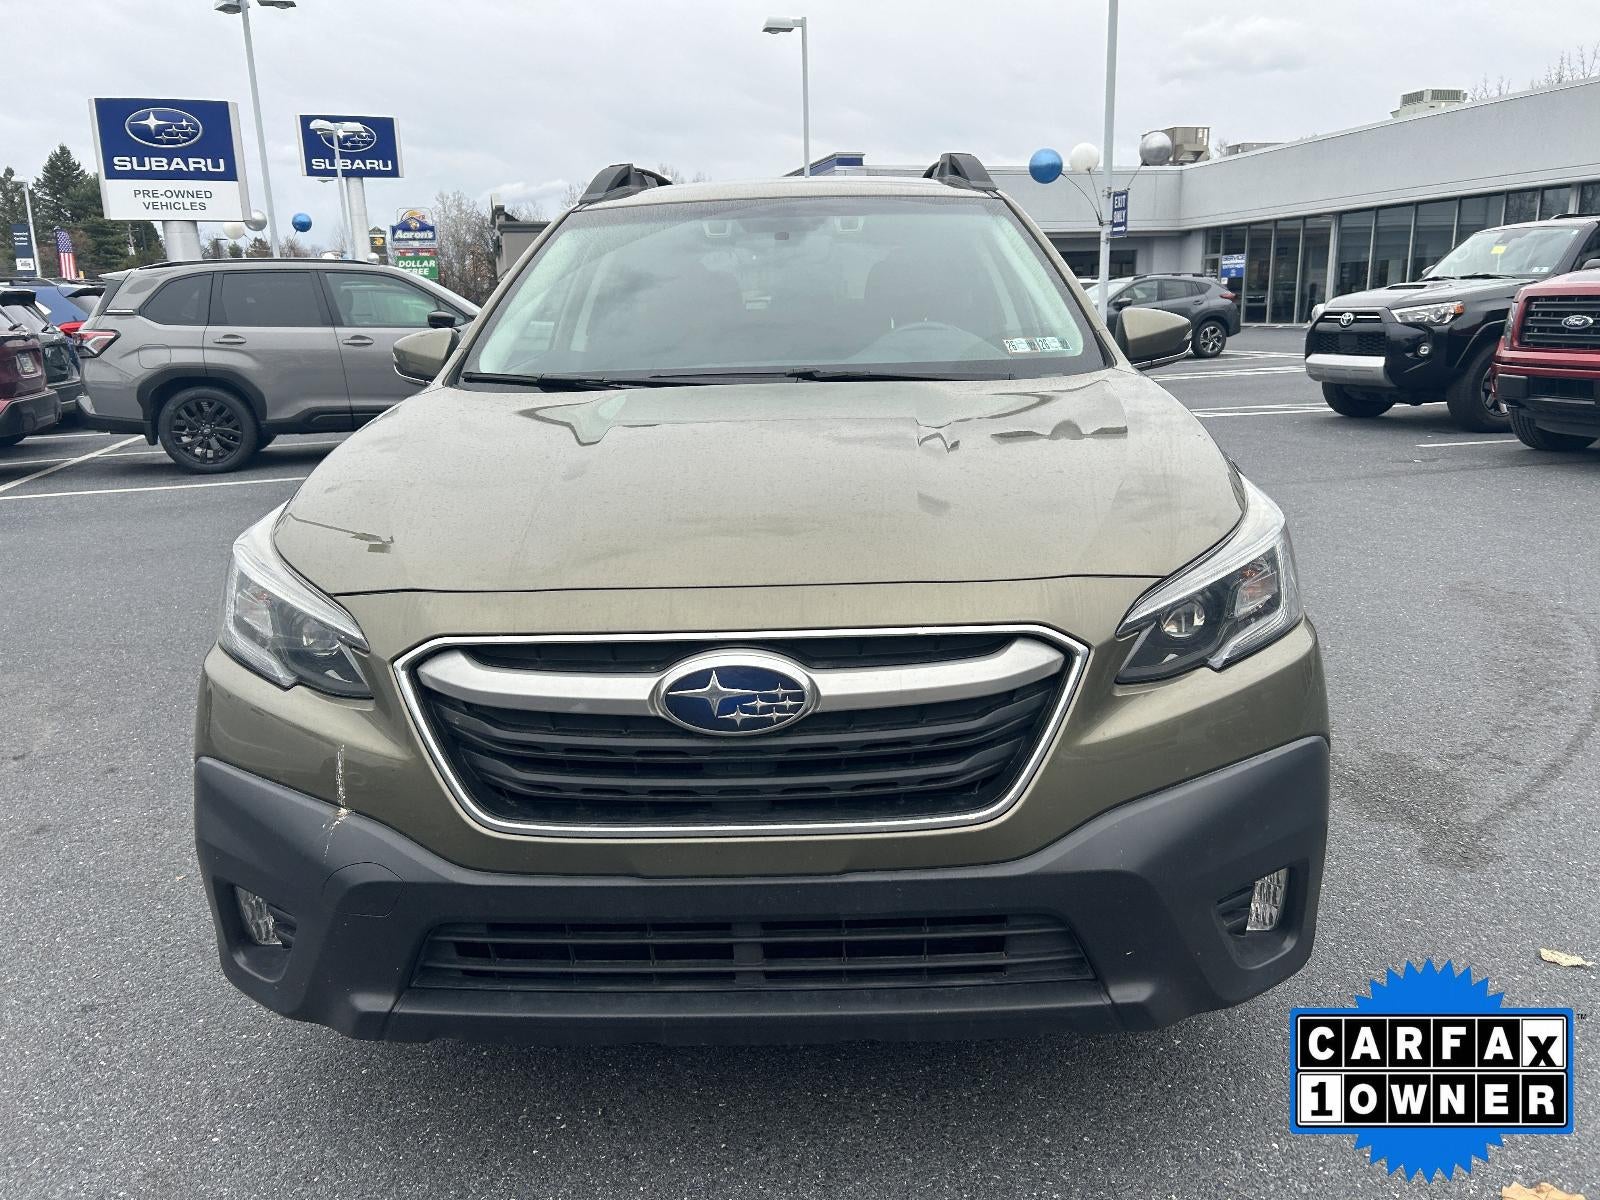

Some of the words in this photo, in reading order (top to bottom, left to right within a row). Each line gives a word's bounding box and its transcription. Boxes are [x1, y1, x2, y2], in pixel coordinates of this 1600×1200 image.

[113, 156, 225, 172] SUBARU
[311, 158, 392, 171] SUBARU
[133, 189, 213, 199] PRE-OWNED
[142, 201, 207, 211] VEHICLES
[1114, 195, 1126, 208] EXIT
[394, 230, 434, 240] Aaron's
[398, 260, 436, 268] DOLLAR
